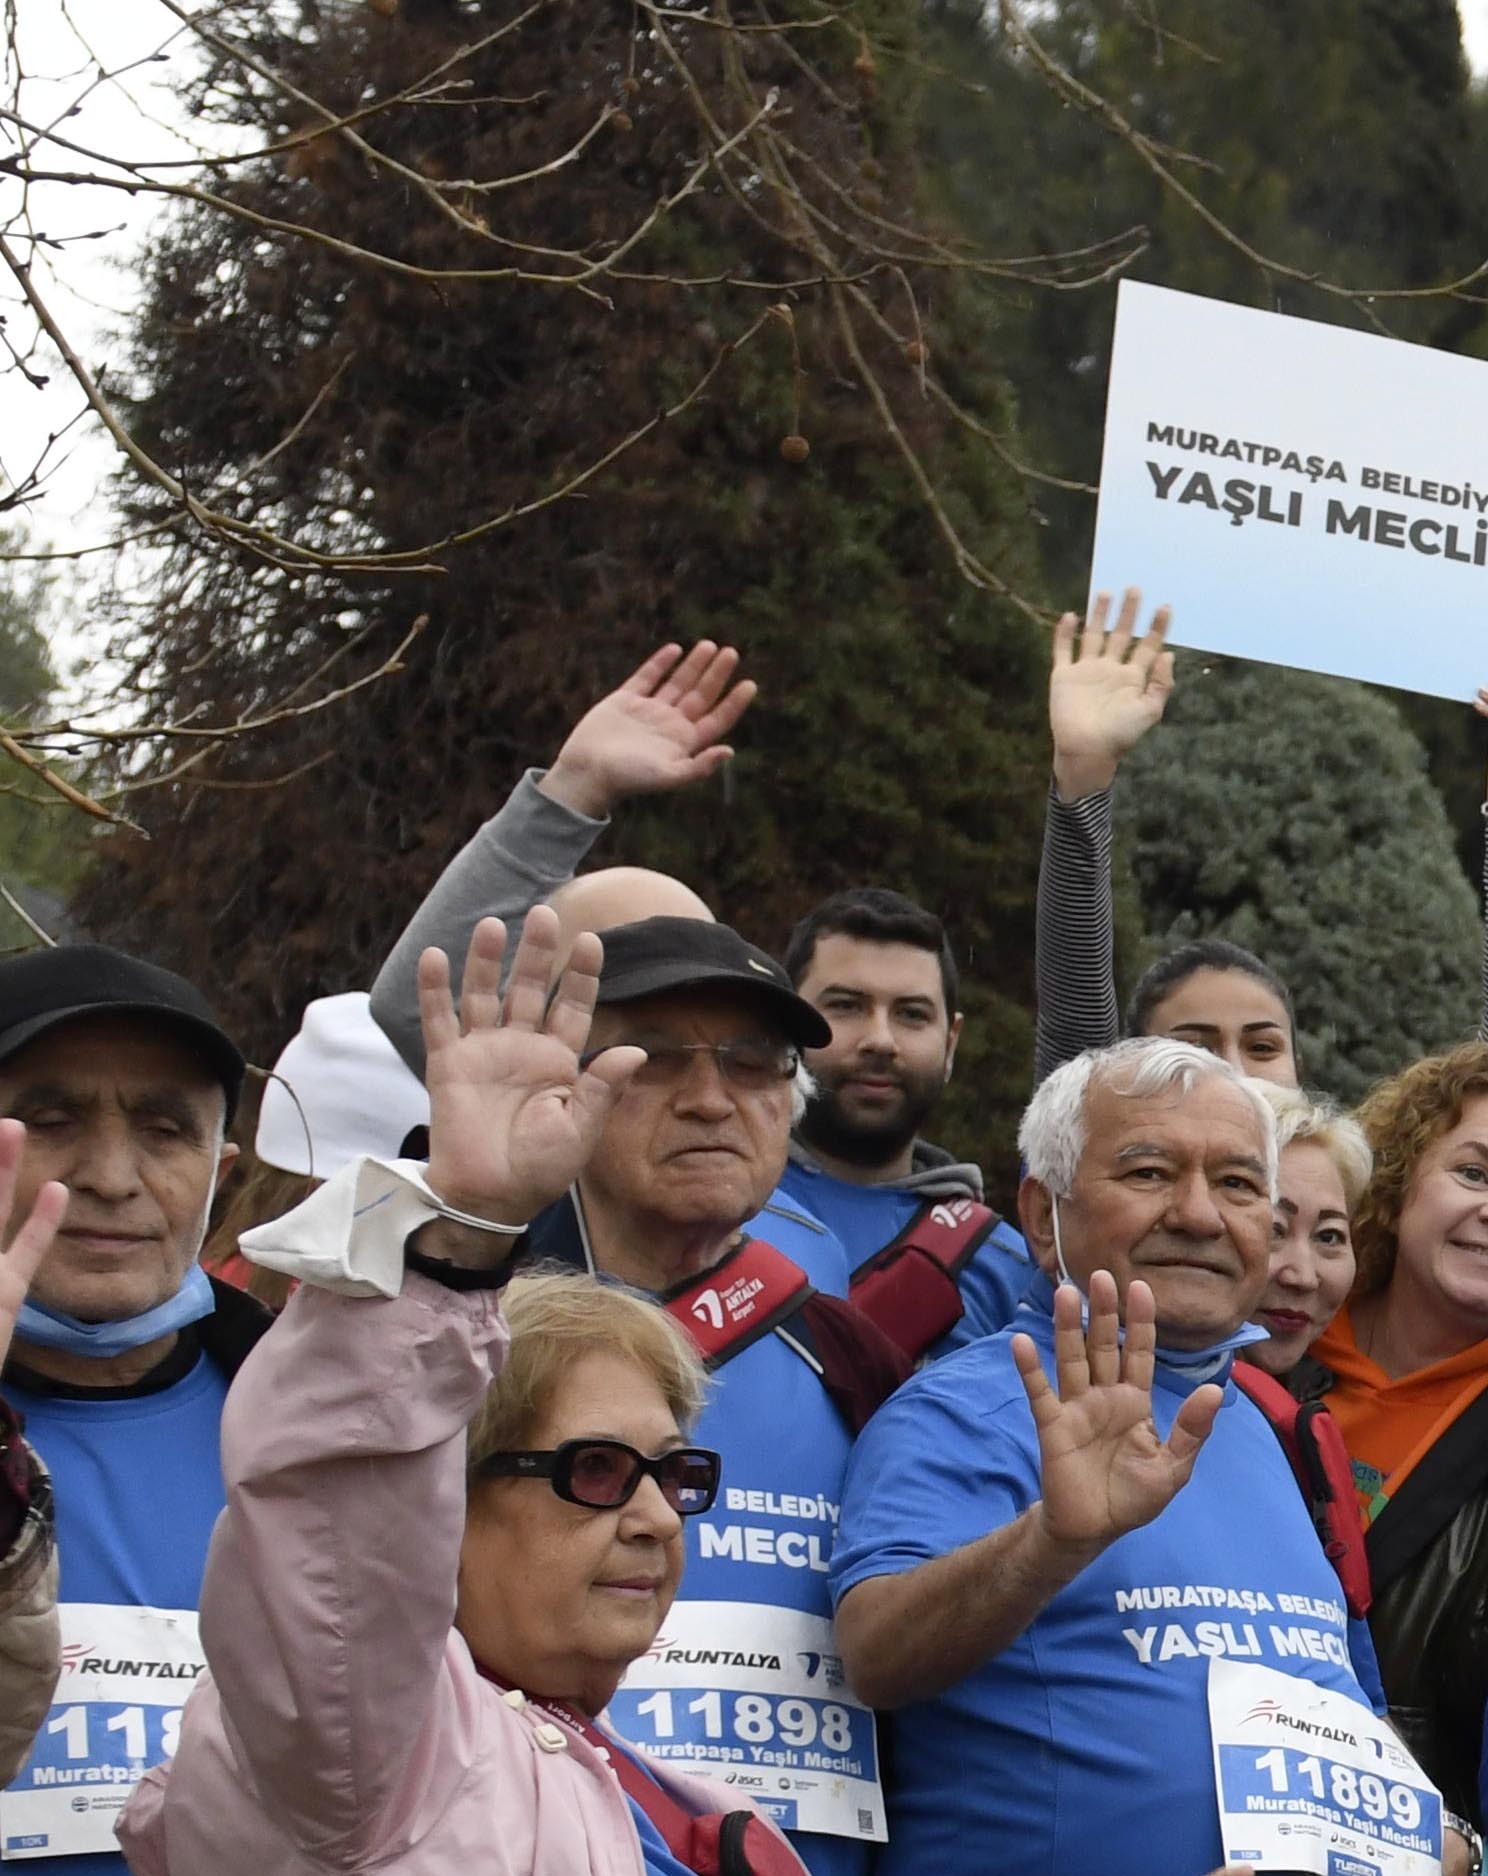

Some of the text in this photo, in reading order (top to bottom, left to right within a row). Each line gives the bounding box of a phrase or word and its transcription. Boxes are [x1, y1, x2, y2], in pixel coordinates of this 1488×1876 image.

[1146, 421, 1347, 483] MURATPAŞA
[1145, 461, 1302, 527] YAŞLI
[726, 1278, 764, 1311] ANTALYA
[700, 1523, 832, 1573] MECL
[1116, 1585, 1274, 1617] MURATPAŞA
[665, 1649, 781, 1671] RUNTALYA
[546, 1702, 586, 1734] Airport
[637, 1690, 854, 1754] 11898
[1276, 1713, 1358, 1747] RUNTALYA
[749, 1745, 862, 1776] Yaşlı Meclisi
[1255, 1749, 1421, 1830] 11899
[1246, 1796, 1340, 1822] Muratpaşa
[1343, 1811, 1380, 1838] Yaşlı
[1381, 1825, 1432, 1854] Meclisi
